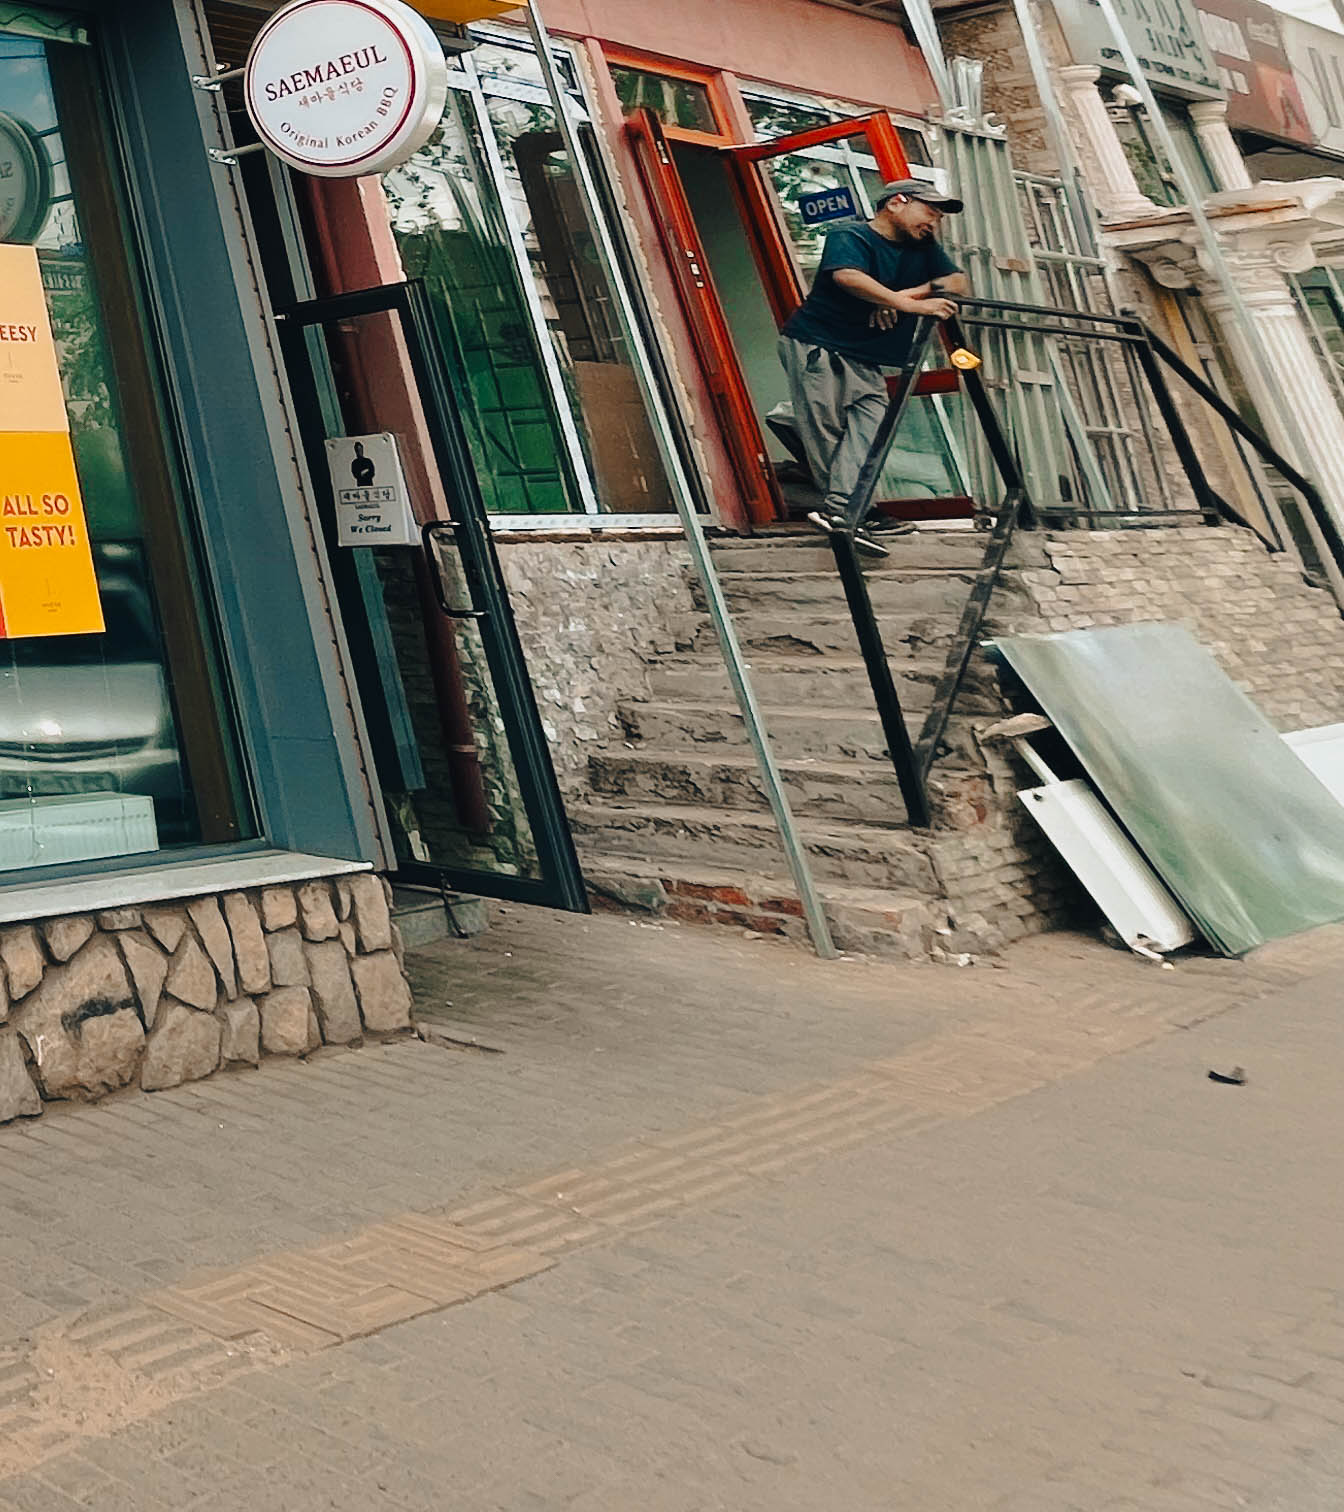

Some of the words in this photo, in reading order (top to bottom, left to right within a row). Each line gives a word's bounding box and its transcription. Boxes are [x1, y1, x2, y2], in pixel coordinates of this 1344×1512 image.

[265, 45, 387, 102] SAEMAEUL
[280, 121, 330, 149] Original
[335, 120, 379, 148] Korean
[376, 86, 399, 117] BBQ
[805, 195, 849, 216] OPEN
[3, 494, 39, 516] ALL
[42, 494, 69, 515] SO
[5, 525, 75, 548] TASTY!
